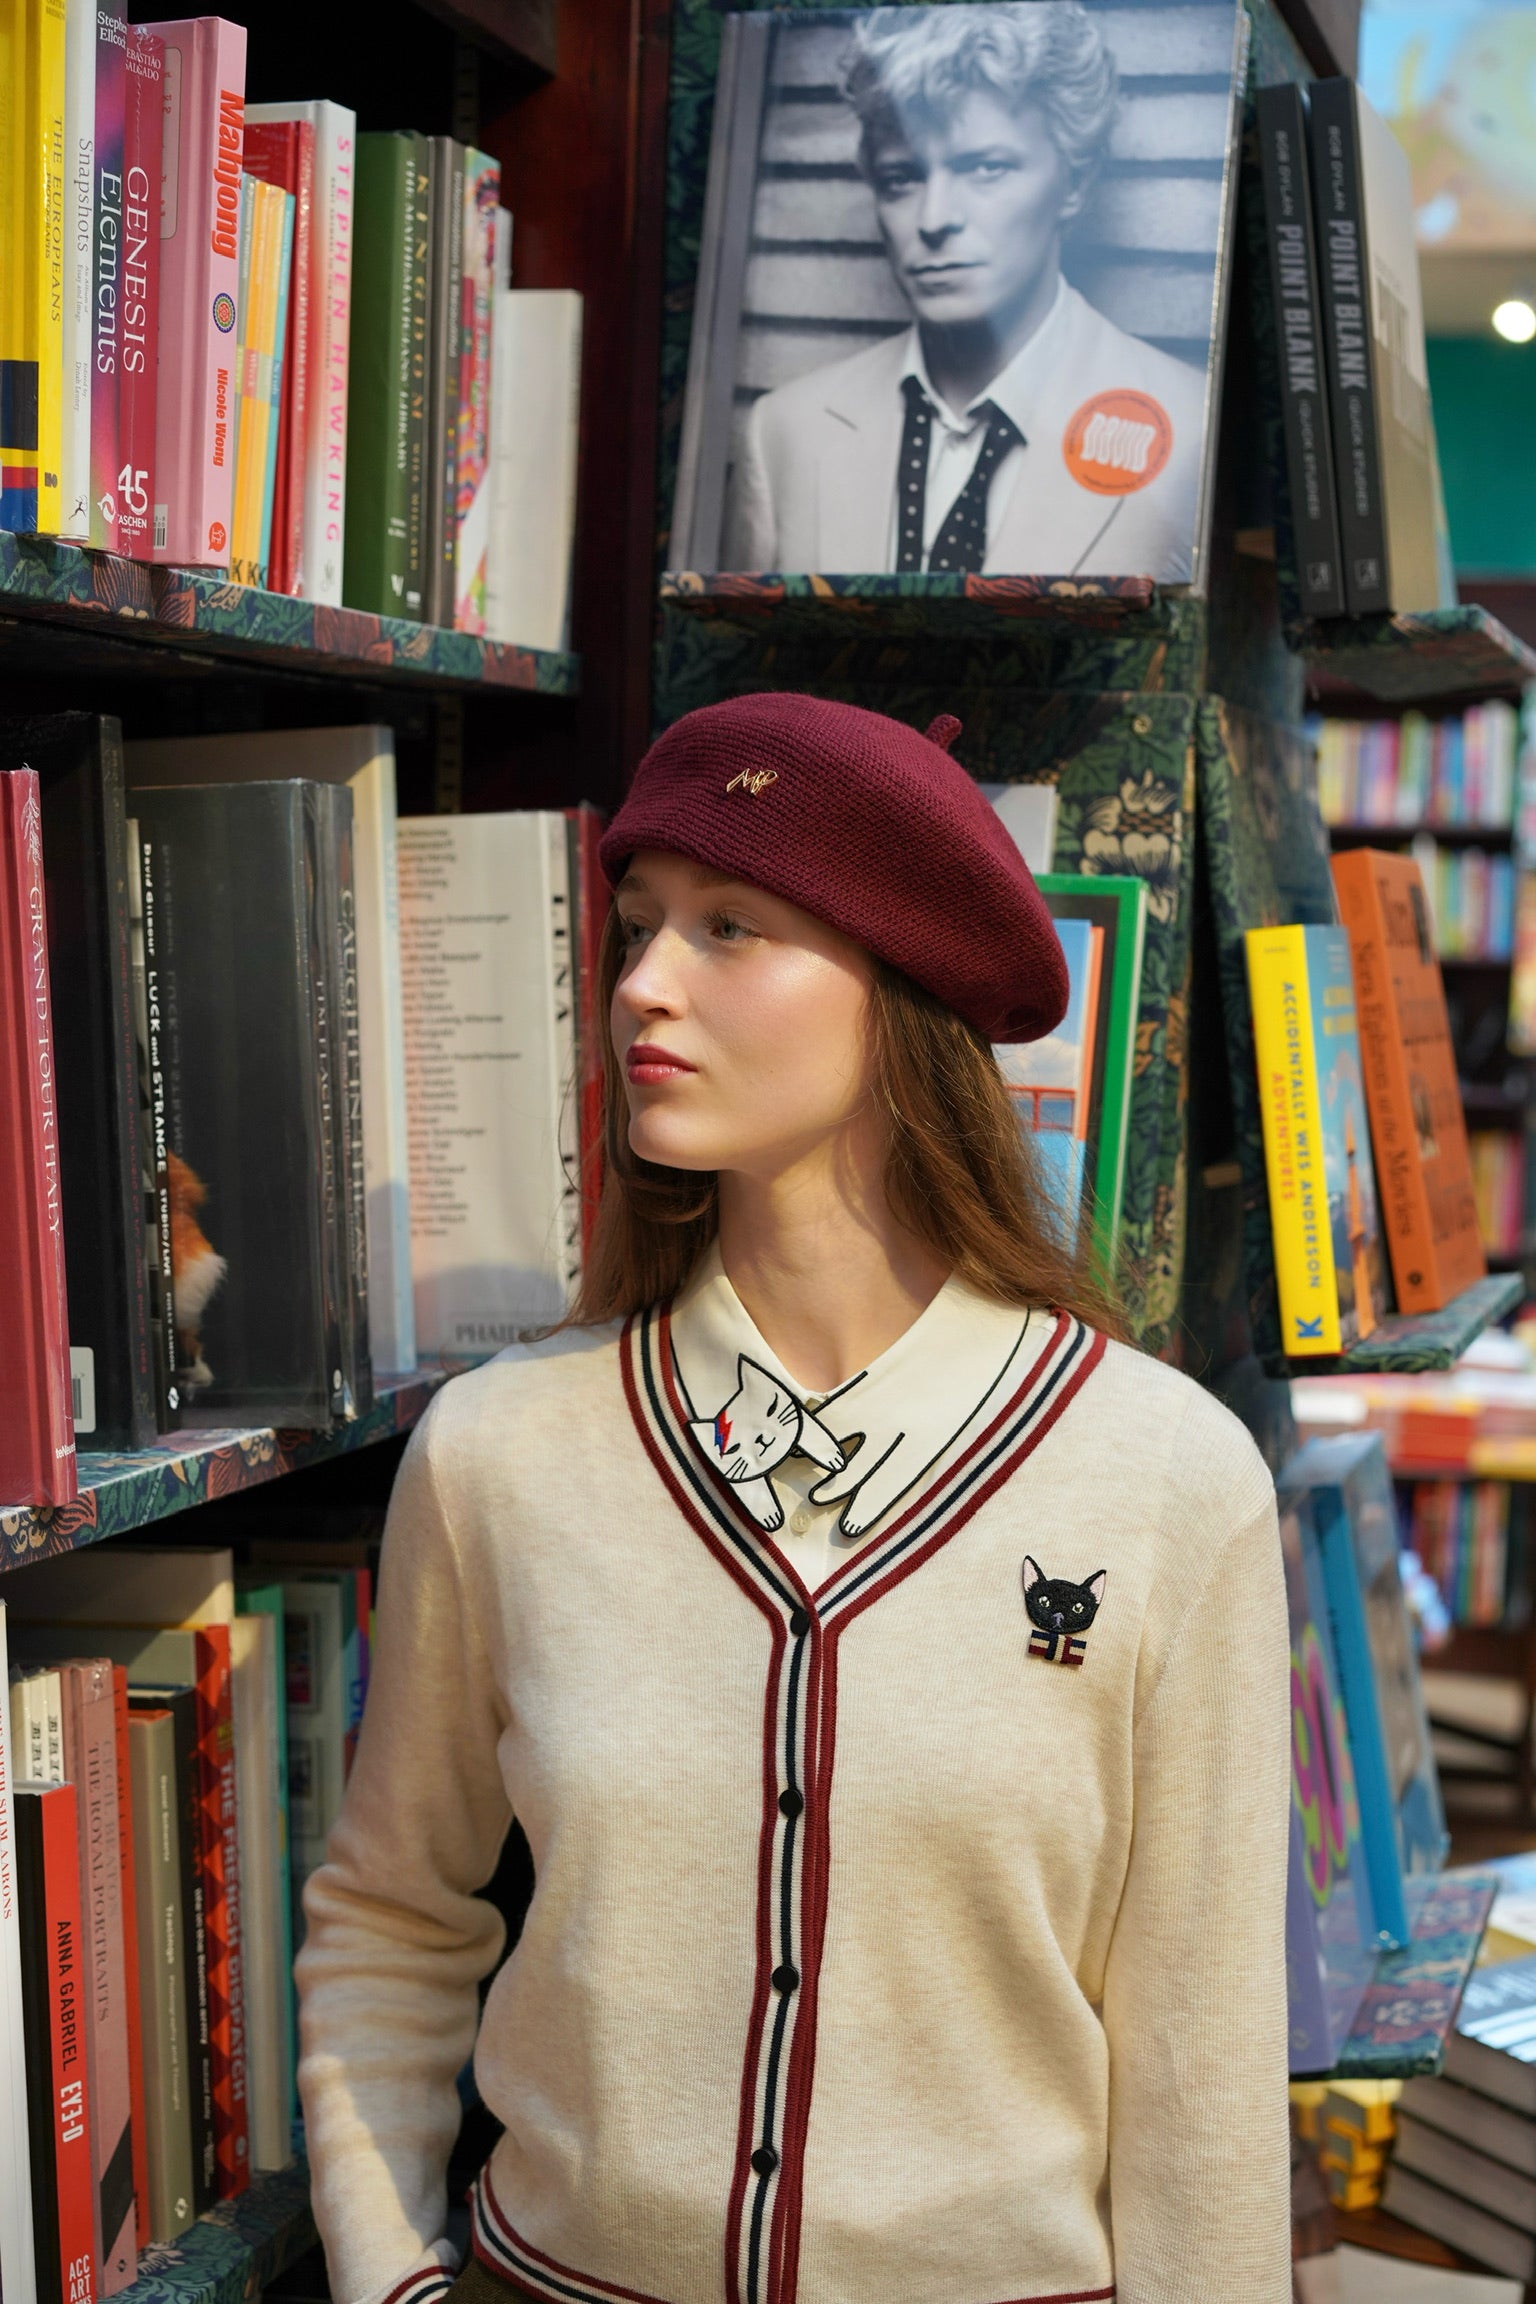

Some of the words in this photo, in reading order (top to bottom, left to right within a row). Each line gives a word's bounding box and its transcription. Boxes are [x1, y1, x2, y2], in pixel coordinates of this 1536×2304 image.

[126, 47, 162, 69] EBASTIÃO
[52, 117, 63, 164] THE
[211, 89, 245, 260] Mahjong
[74, 138, 93, 253] Snapshots
[332, 136, 351, 319] STEPHEN
[50, 176, 63, 322] EUROPEANS
[97, 168, 121, 375] Elements
[123, 166, 149, 373] GENESIS
[1276, 224, 1309, 301] POINT
[1328, 220, 1360, 298] POINT
[1283, 307, 1317, 393] BLANK
[1334, 304, 1367, 389] BLANK
[216, 368, 228, 419] Nicole
[213, 421, 226, 467] Wong
[326, 343, 346, 541] HAWKING
[118, 464, 148, 515] 45
[118, 515, 147, 529] ASCHEN
[143, 842, 153, 887] David
[29, 886, 48, 1021] GRAND
[145, 891, 156, 956] Gilmour
[147, 970, 161, 1033] LUCK
[36, 1030, 54, 1133] TOUR
[150, 1036, 161, 1067] and
[1283, 981, 1307, 1119] ACCIDENTALLY
[152, 1071, 167, 1173] STRANGE
[1272, 1072, 1295, 1200] ADVENTURES
[1296, 1131, 1311, 1170] WES
[45, 1143, 60, 1235] ITALY
[159, 1187, 172, 1278] STUDIO/LIVE
[1301, 1181, 1320, 1288] ANDERSON
[88, 1742, 101, 1790] THE
[219, 1760, 235, 1818] THE
[90, 1798, 104, 1880] ROYAL
[1, 1848, 12, 1920] AARONS
[222, 1826, 241, 1946] FRENCH
[57, 1920, 74, 1977] ANNA
[92, 1886, 110, 2023] PORTRAITS
[59, 1982, 78, 2072] GABRIEL
[68, 2253, 91, 2283] ACC
[70, 2273, 91, 2304] ART
